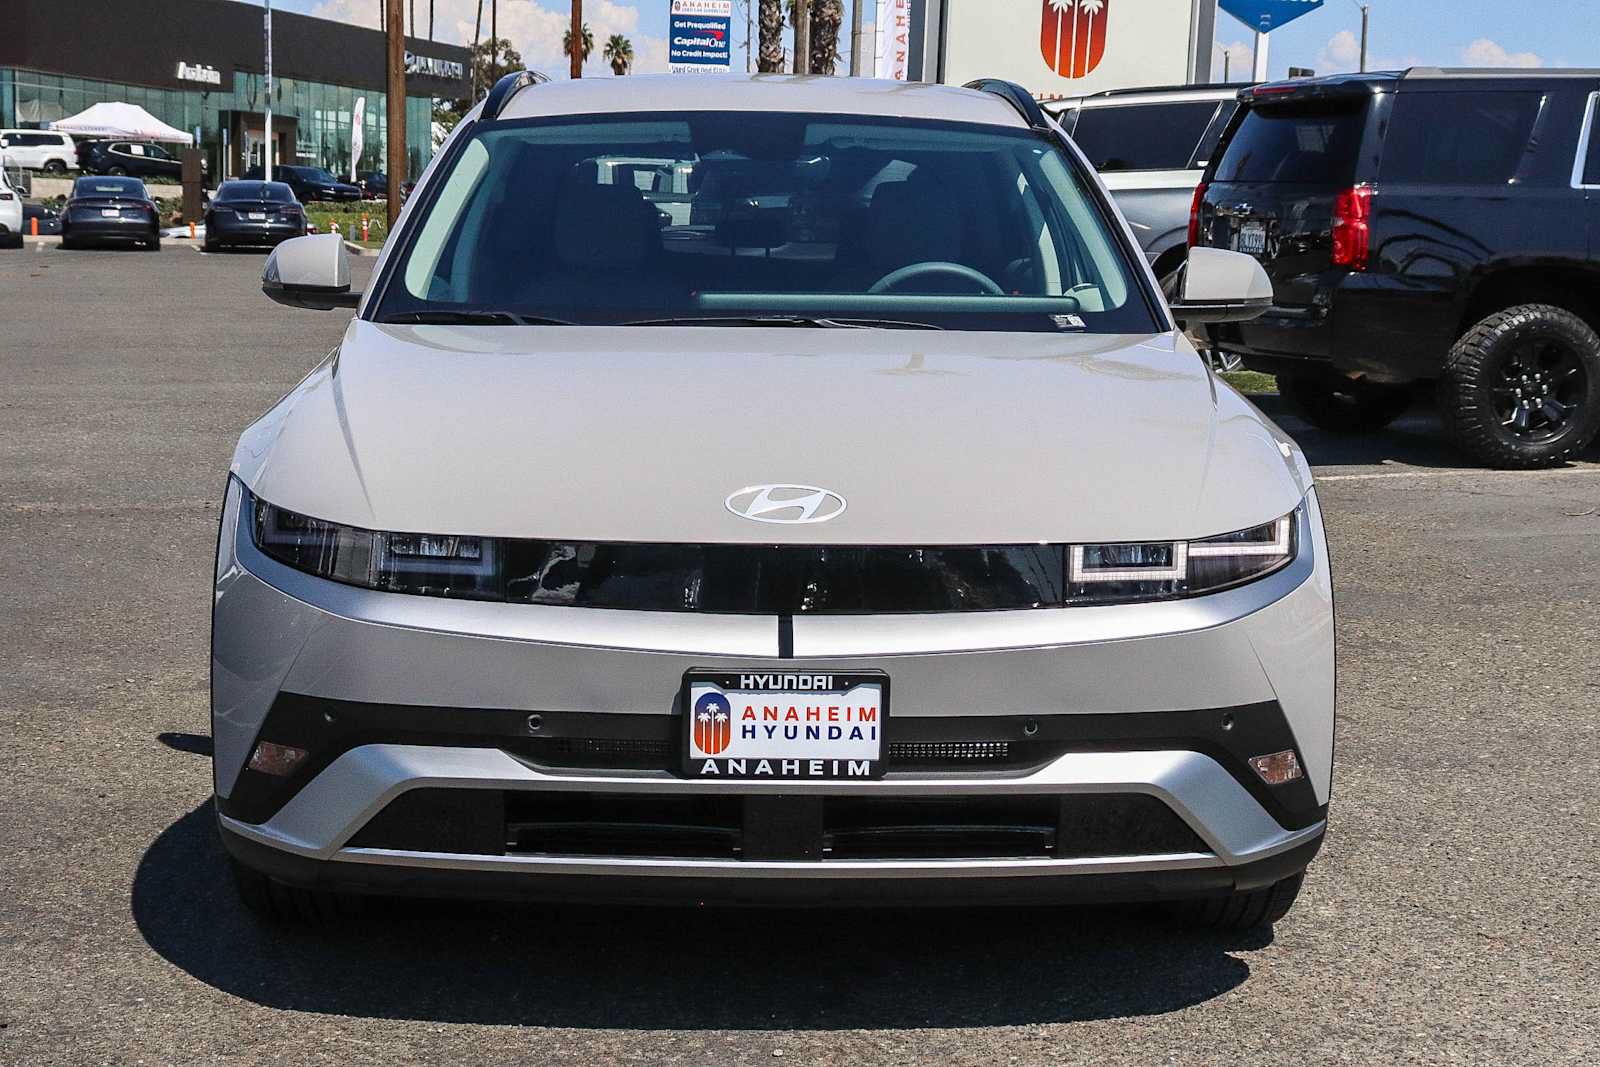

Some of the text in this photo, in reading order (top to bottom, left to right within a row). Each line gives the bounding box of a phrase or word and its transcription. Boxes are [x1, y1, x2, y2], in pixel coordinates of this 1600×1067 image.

[740, 674, 833, 690] HYUNDAI
[741, 705, 876, 721] ANAHEIM
[741, 725, 876, 740] HYUNDAI
[700, 759, 870, 776] ANAHEIM
